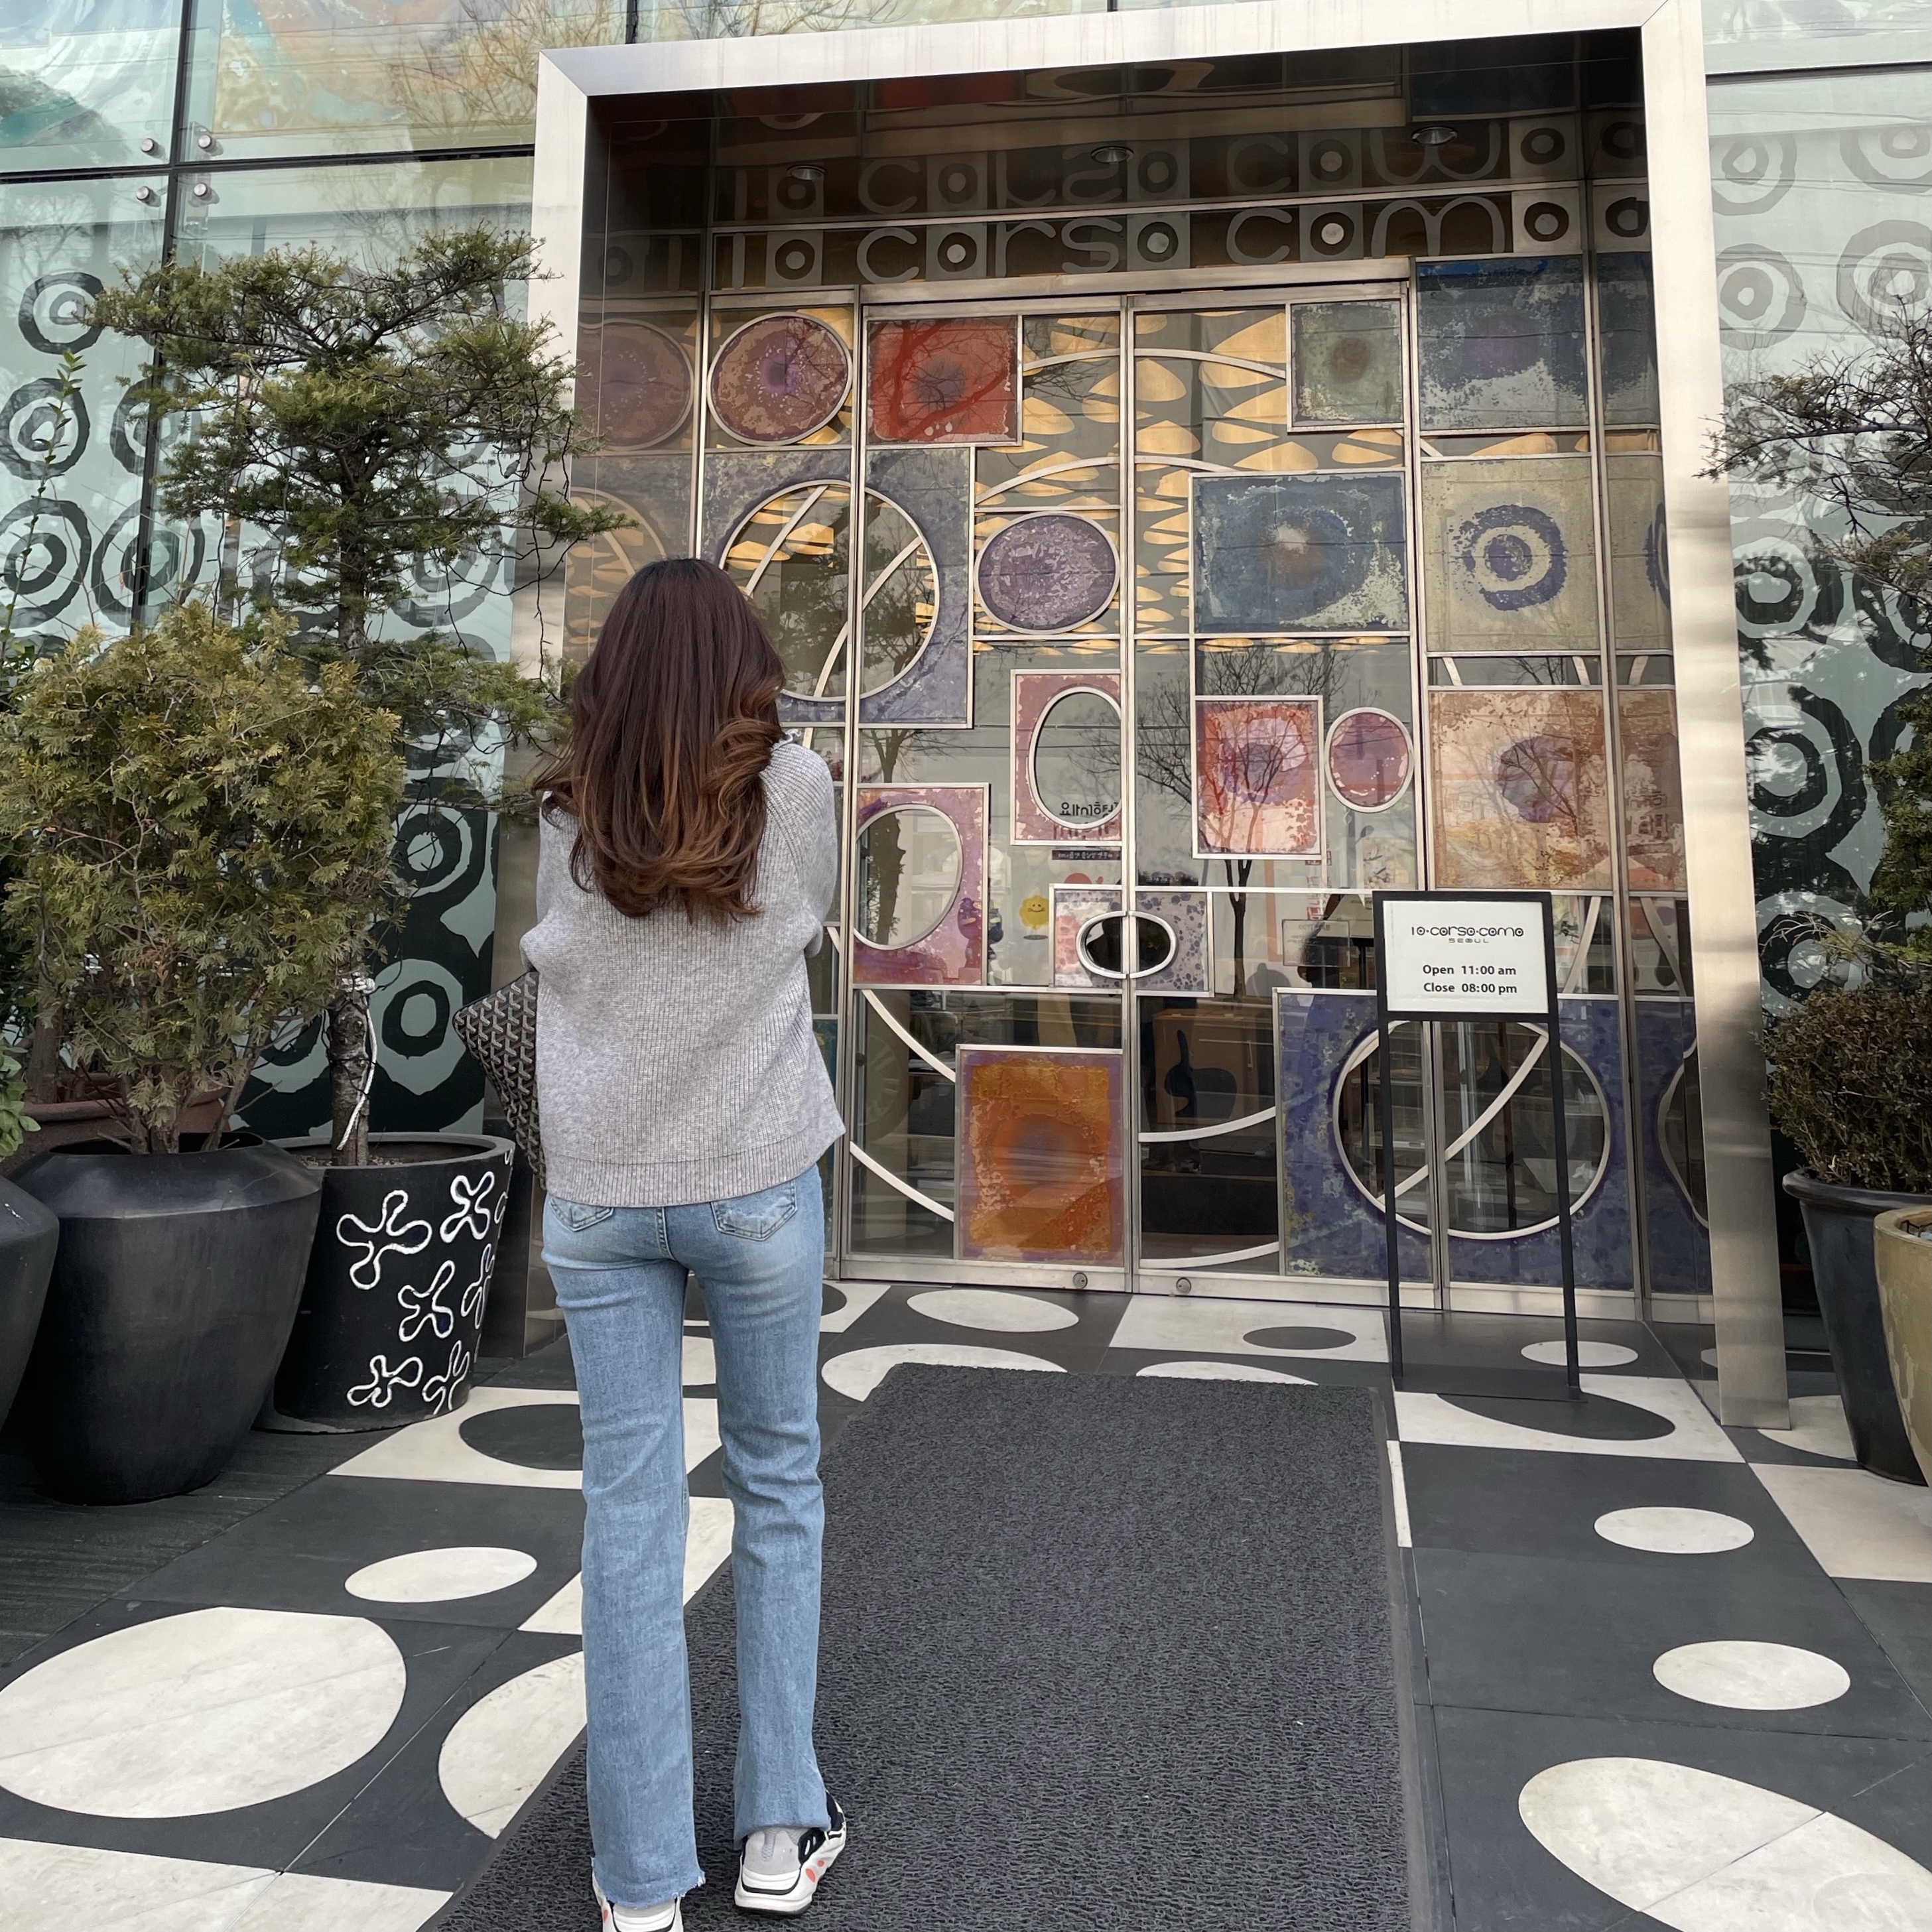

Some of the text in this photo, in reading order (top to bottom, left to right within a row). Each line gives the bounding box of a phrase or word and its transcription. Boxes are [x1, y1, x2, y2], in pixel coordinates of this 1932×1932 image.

[856, 216, 1179, 284] corso
[1226, 196, 1569, 265] como
[1423, 964, 1454, 976] Open
[1461, 965, 1495, 975] 11:00
[1423, 982, 1517, 995] Close 08:00 pm
